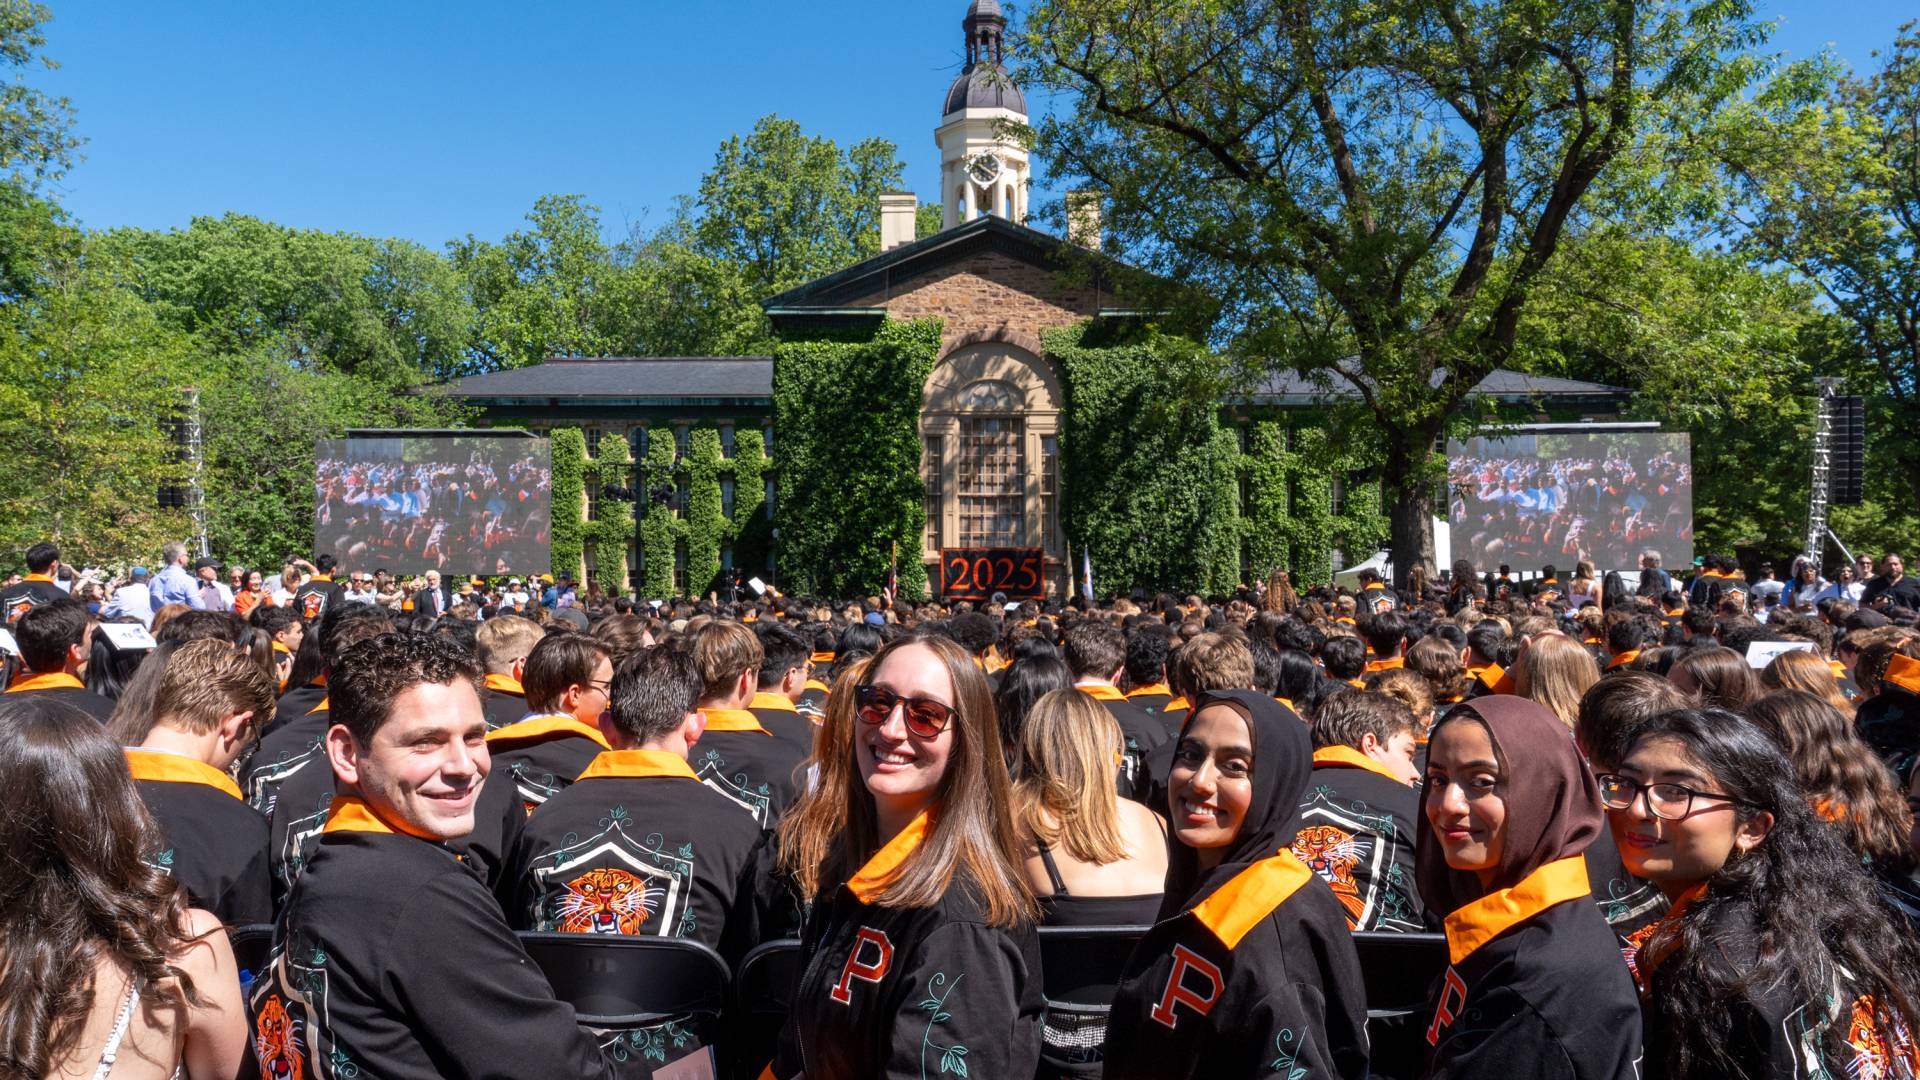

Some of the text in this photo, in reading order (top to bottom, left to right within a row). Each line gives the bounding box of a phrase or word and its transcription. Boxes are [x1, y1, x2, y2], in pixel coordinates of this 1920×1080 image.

[950, 557, 1037, 591] 2025
[830, 925, 895, 1006] P
[1151, 943, 1225, 1030] P
[1426, 964, 1467, 1047] P
